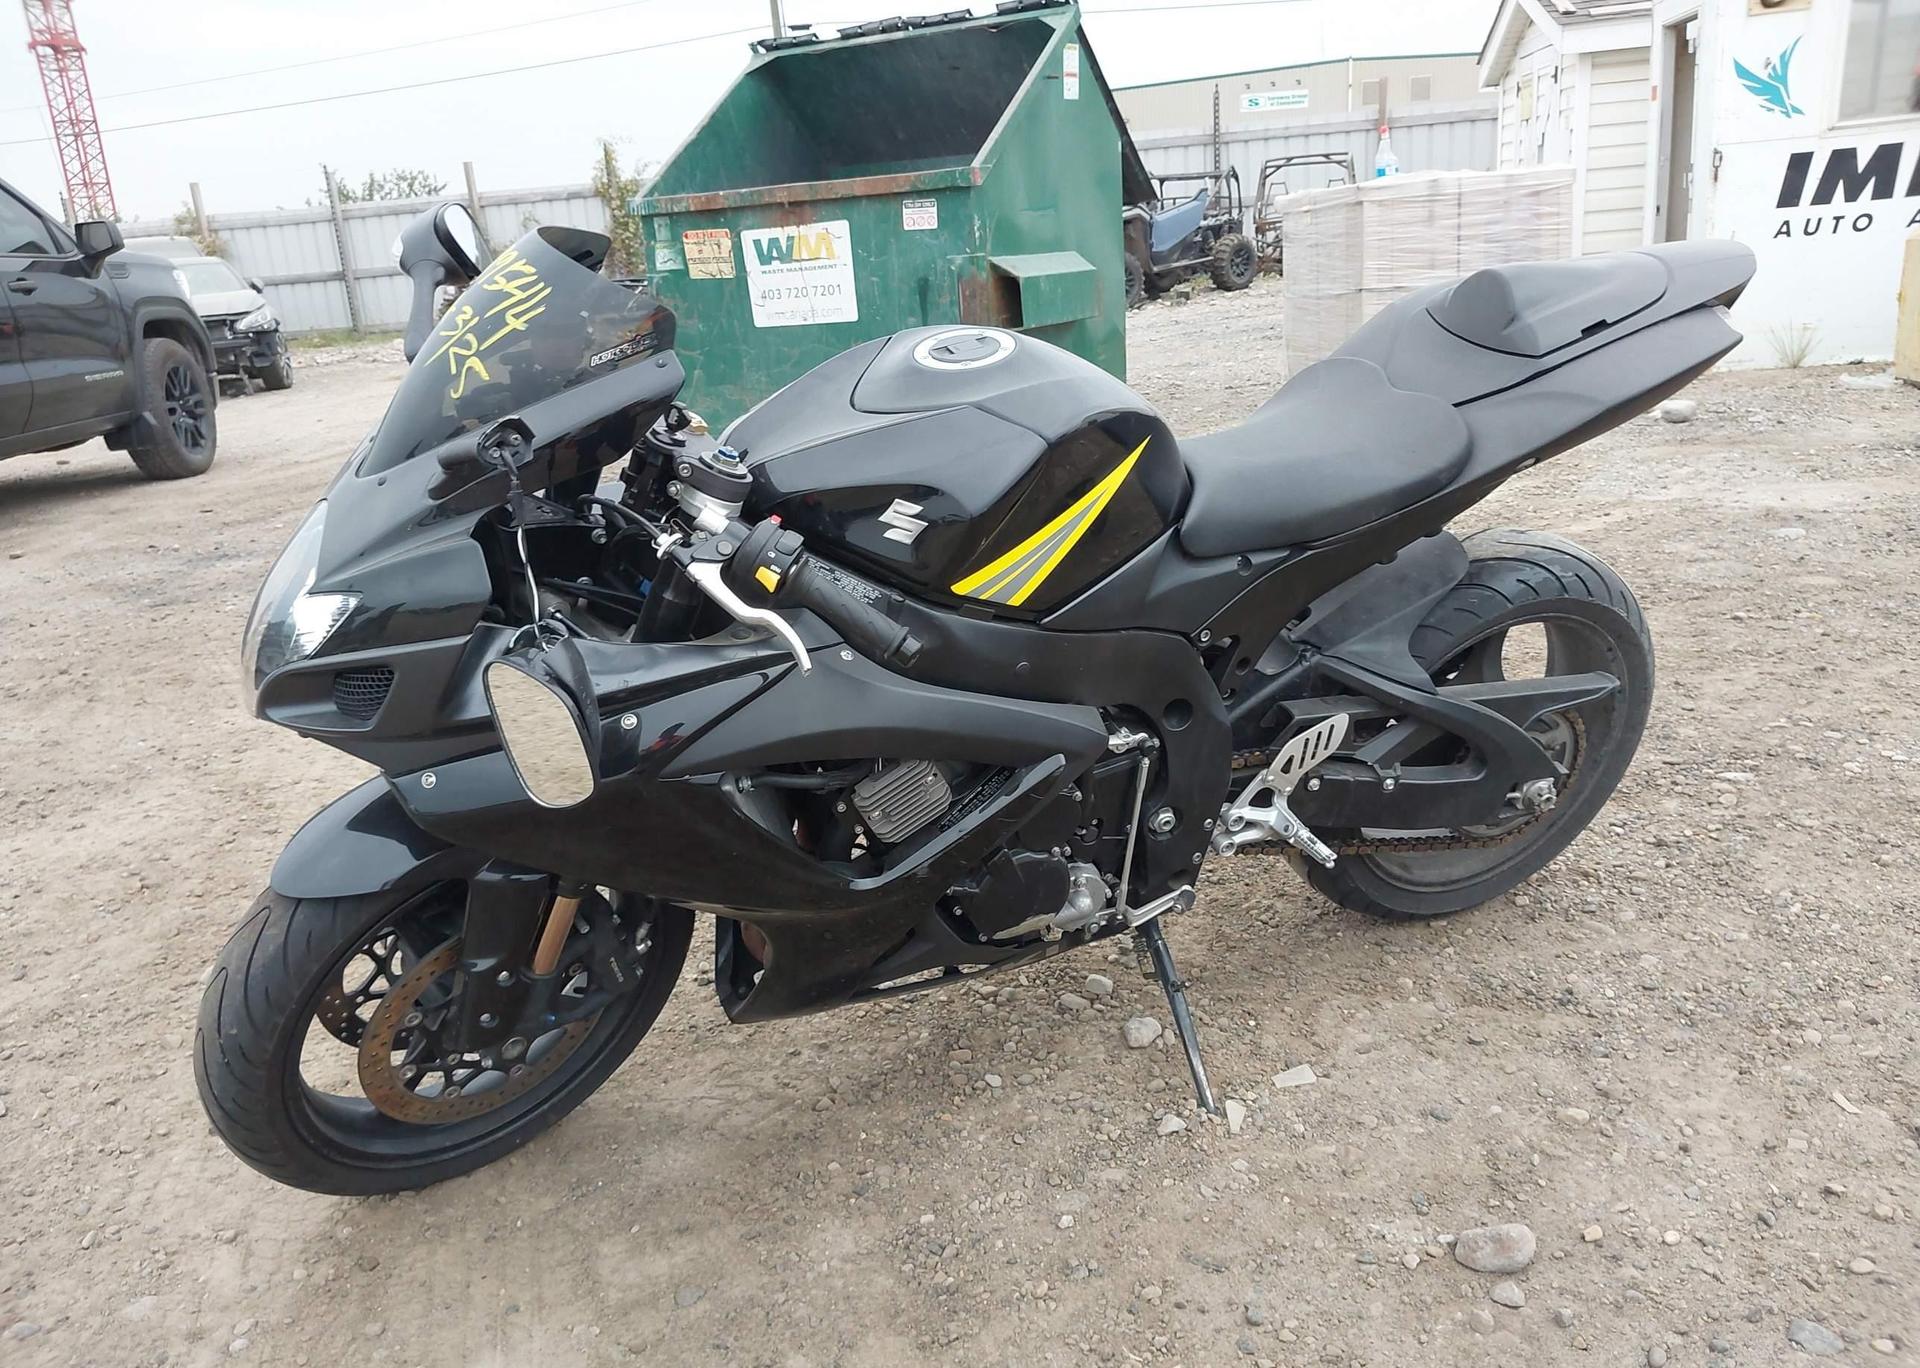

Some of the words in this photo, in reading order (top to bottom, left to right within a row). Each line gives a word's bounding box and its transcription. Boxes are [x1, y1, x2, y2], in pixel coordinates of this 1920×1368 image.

[1773, 213, 1874, 239] AUTO
[752, 231, 836, 266] WM
[761, 267, 785, 275] WASTE
[786, 263, 838, 273] MANAGEMENT
[761, 288, 782, 301] 403
[785, 286, 809, 299] 720
[811, 284, 842, 298] 7201
